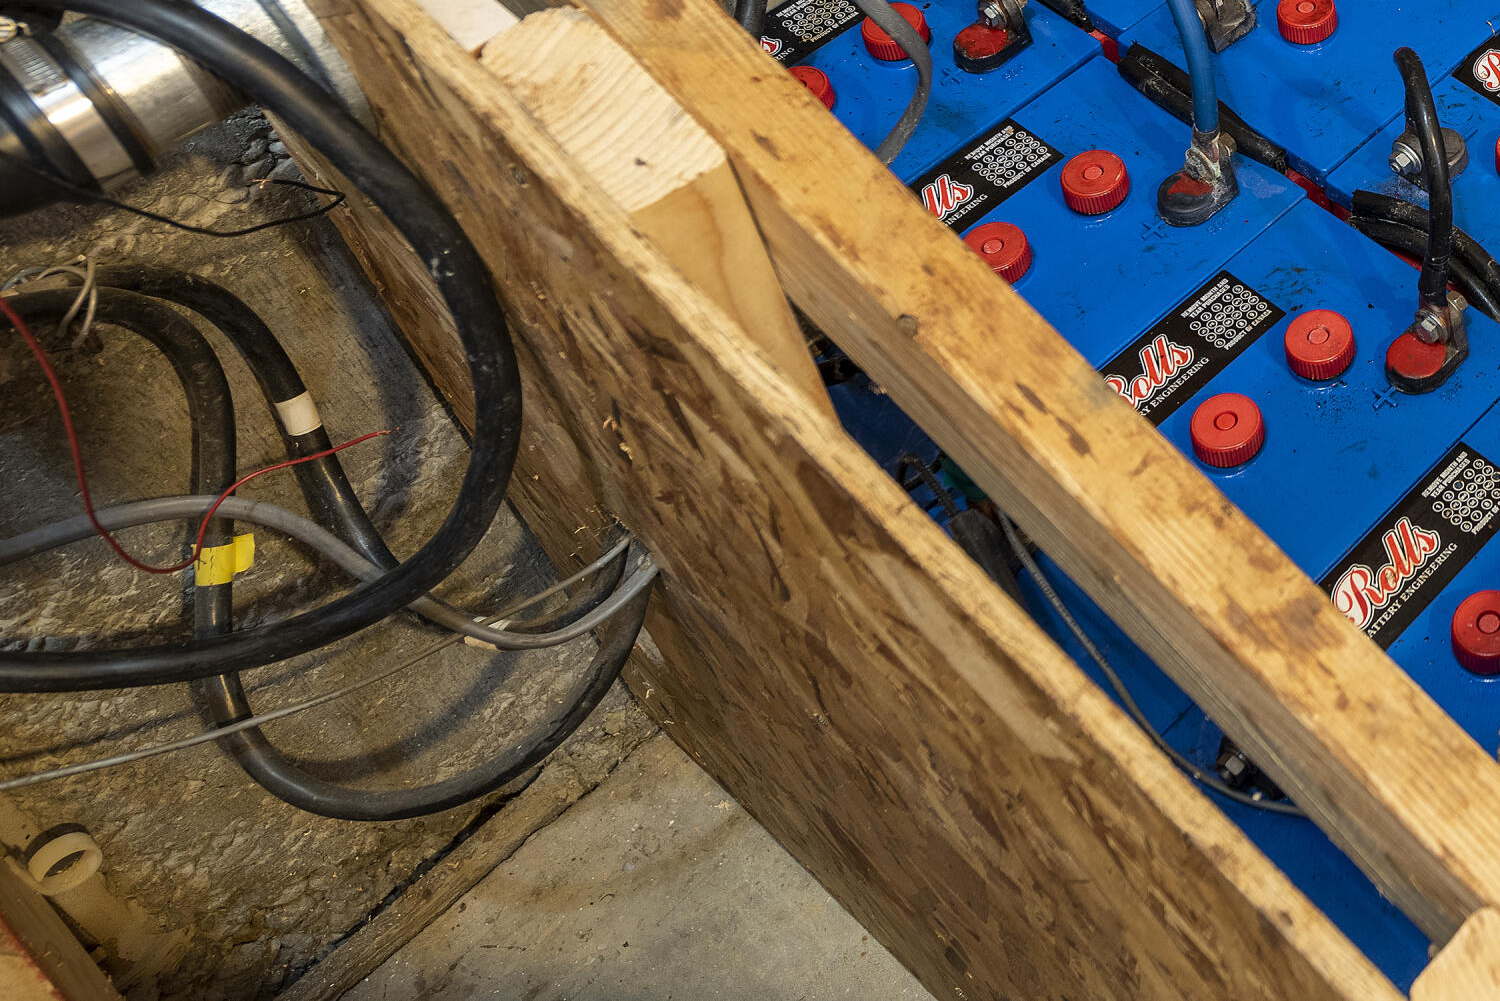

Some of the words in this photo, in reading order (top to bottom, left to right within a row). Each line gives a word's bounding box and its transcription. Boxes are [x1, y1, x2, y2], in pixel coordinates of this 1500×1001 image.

[921, 175, 974, 220] lls
[945, 194, 988, 225] INEERING
[1105, 334, 1194, 410] olls
[1150, 357, 1208, 406] ENGINEERING
[1331, 517, 1440, 630] Rolls
[1368, 600, 1401, 637] ATTERY
[1400, 543, 1457, 601] ENGINEERING
